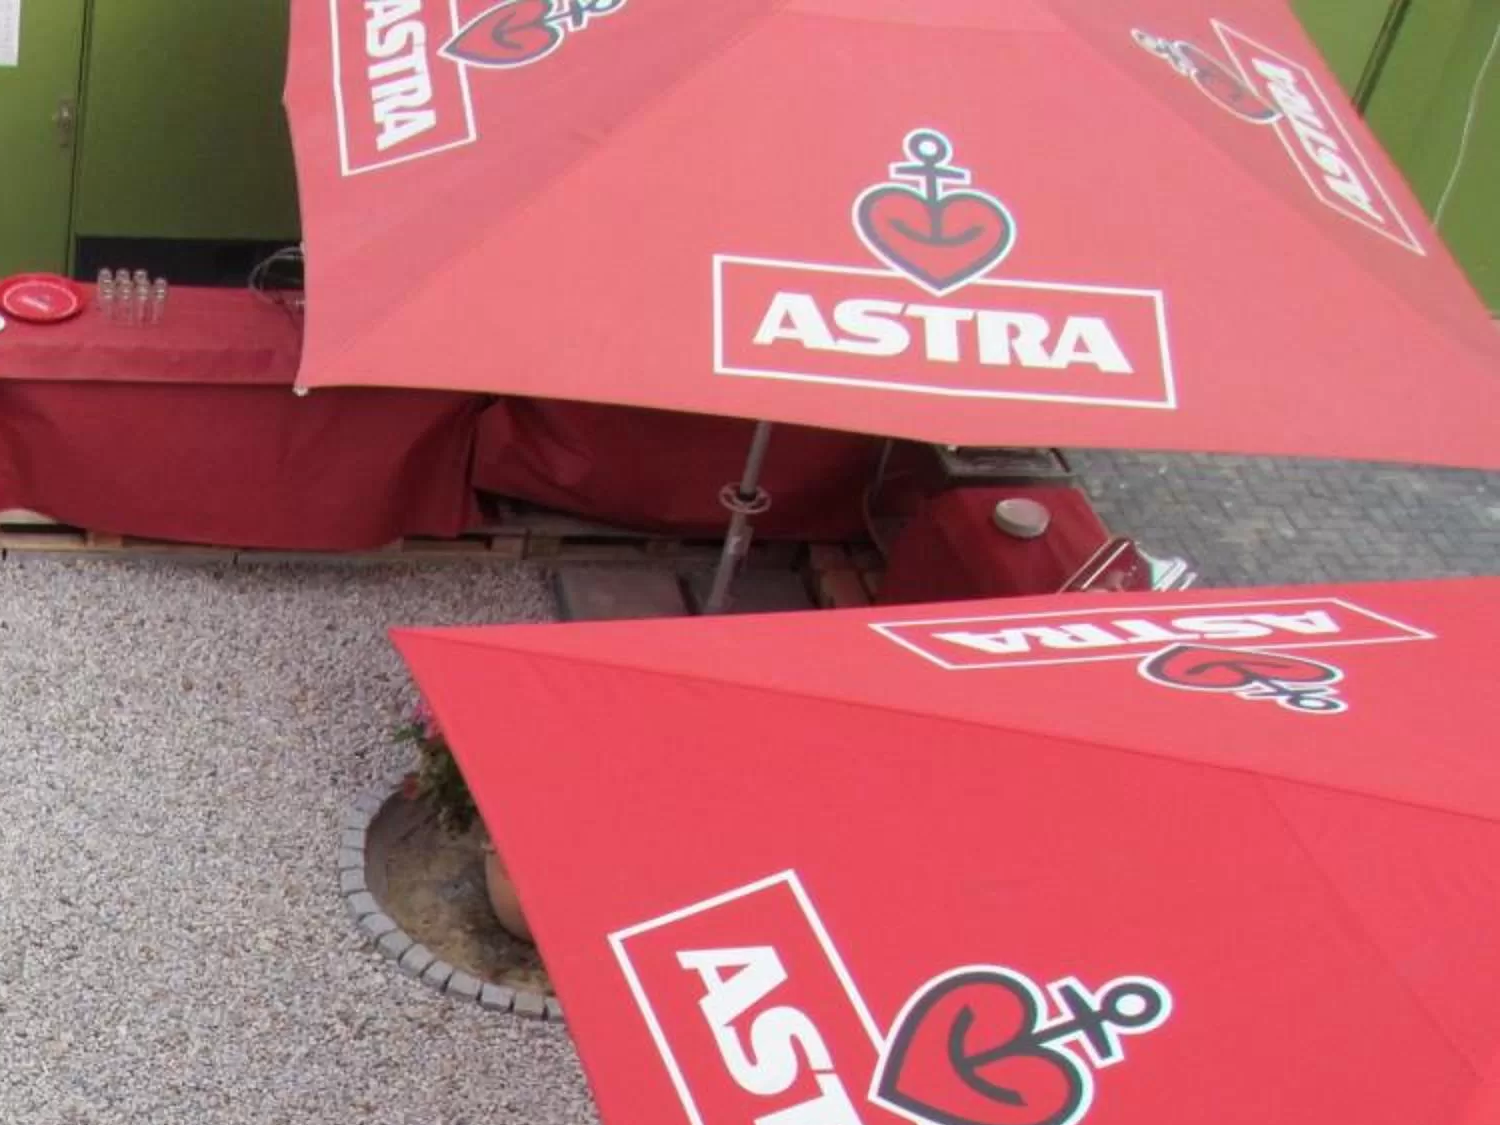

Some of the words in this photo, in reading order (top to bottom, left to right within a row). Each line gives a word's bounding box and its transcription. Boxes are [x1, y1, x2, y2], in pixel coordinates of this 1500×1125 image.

[365, 0, 436, 150] ASTRA
[753, 292, 1134, 374] ASTRA
[932, 610, 1341, 654] ASTRA
